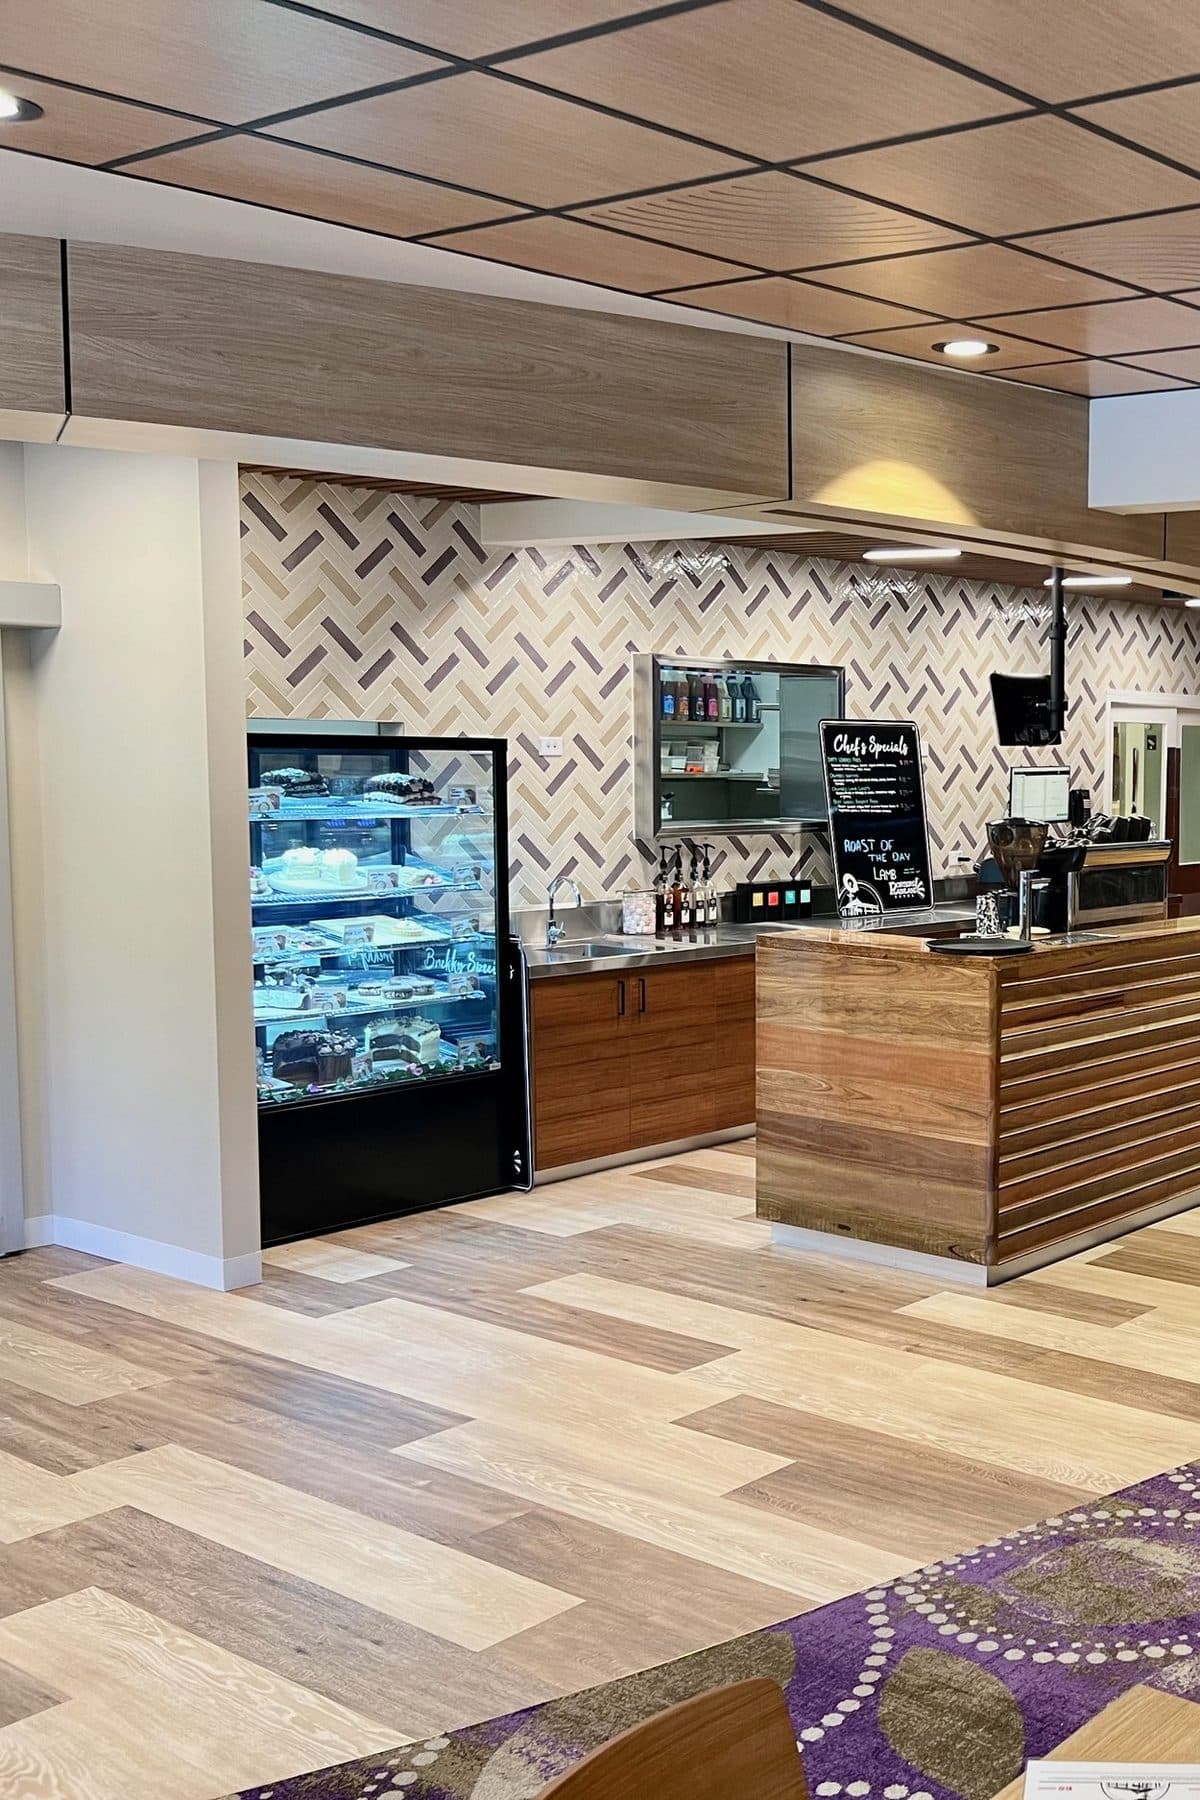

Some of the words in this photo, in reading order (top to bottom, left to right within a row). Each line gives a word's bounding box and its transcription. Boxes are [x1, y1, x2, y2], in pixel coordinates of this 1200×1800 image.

[868, 735, 909, 759] Specials
[843, 838, 876, 853] ROAST
[880, 839, 895, 851] OF
[867, 853, 888, 863] THE
[891, 851, 911, 862] DAY
[872, 866, 897, 880] LAMB
